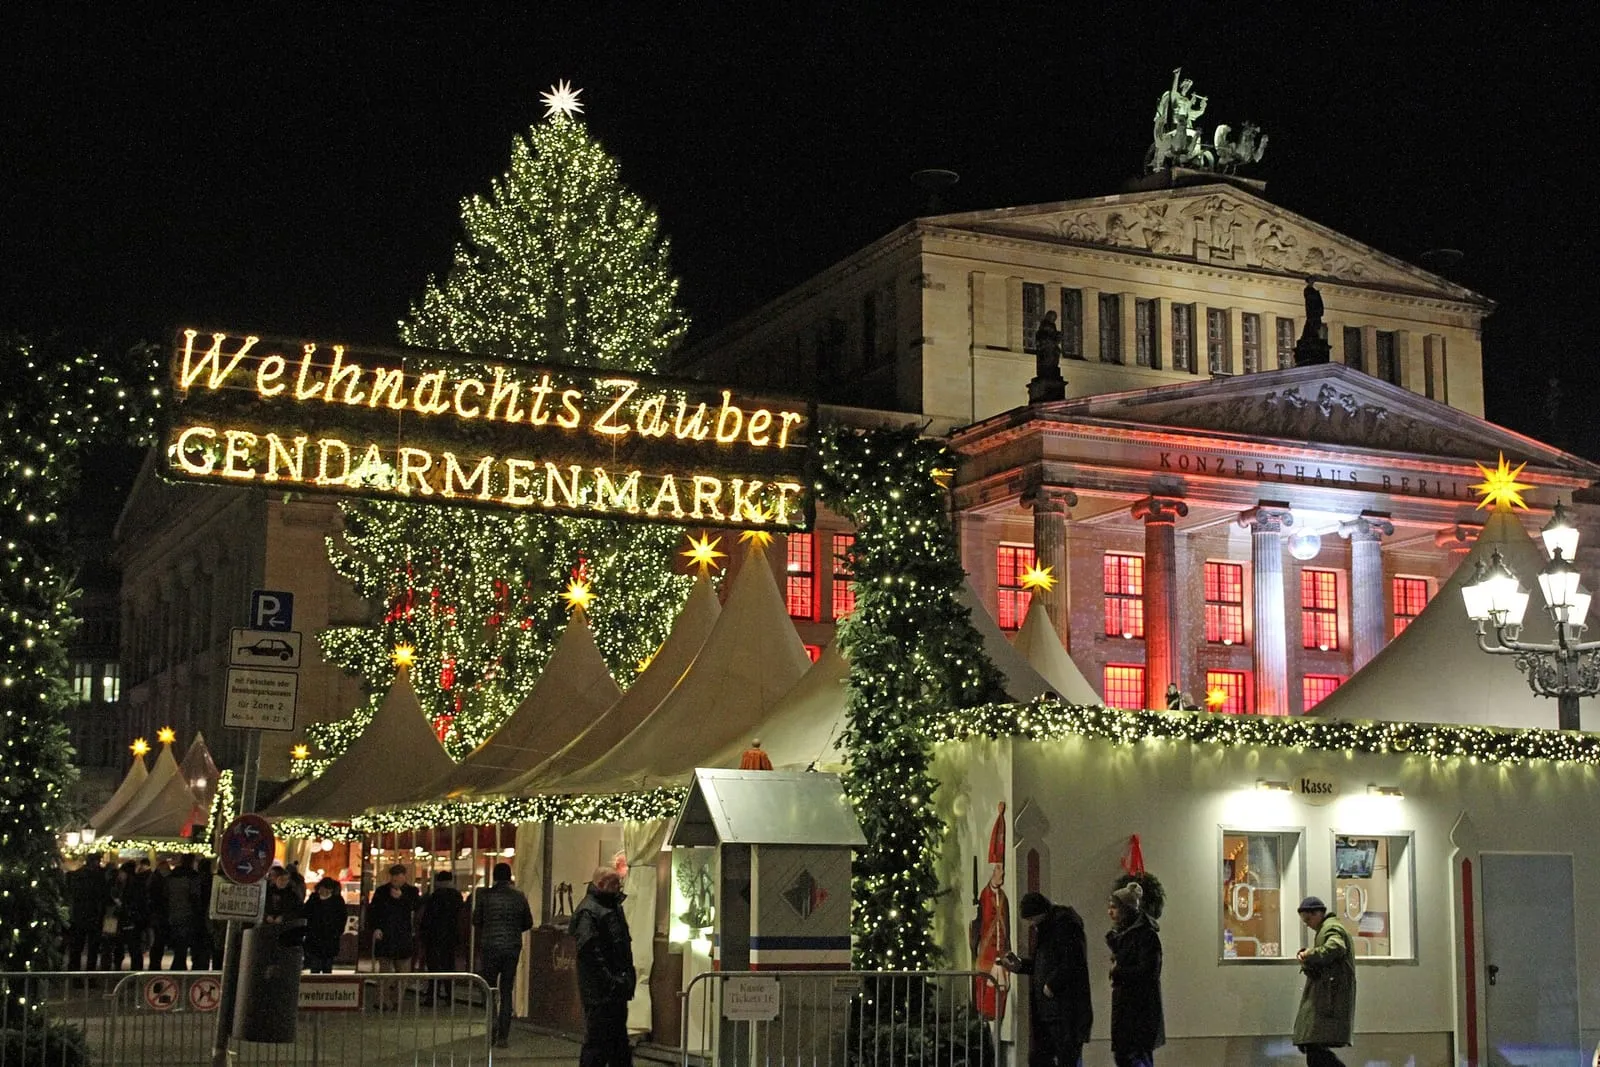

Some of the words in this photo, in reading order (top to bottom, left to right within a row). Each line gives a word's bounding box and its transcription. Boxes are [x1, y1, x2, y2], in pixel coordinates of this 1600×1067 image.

[176, 426, 801, 525] GENDARMENMARKT
[1159, 452, 1358, 485] KONZERTHAUS
[257, 595, 281, 626] P
[252, 700, 275, 711] Zone
[278, 702, 284, 711] 2
[1300, 778, 1333, 794] Kasse
[299, 989, 356, 1001] rwehrzufahrt
